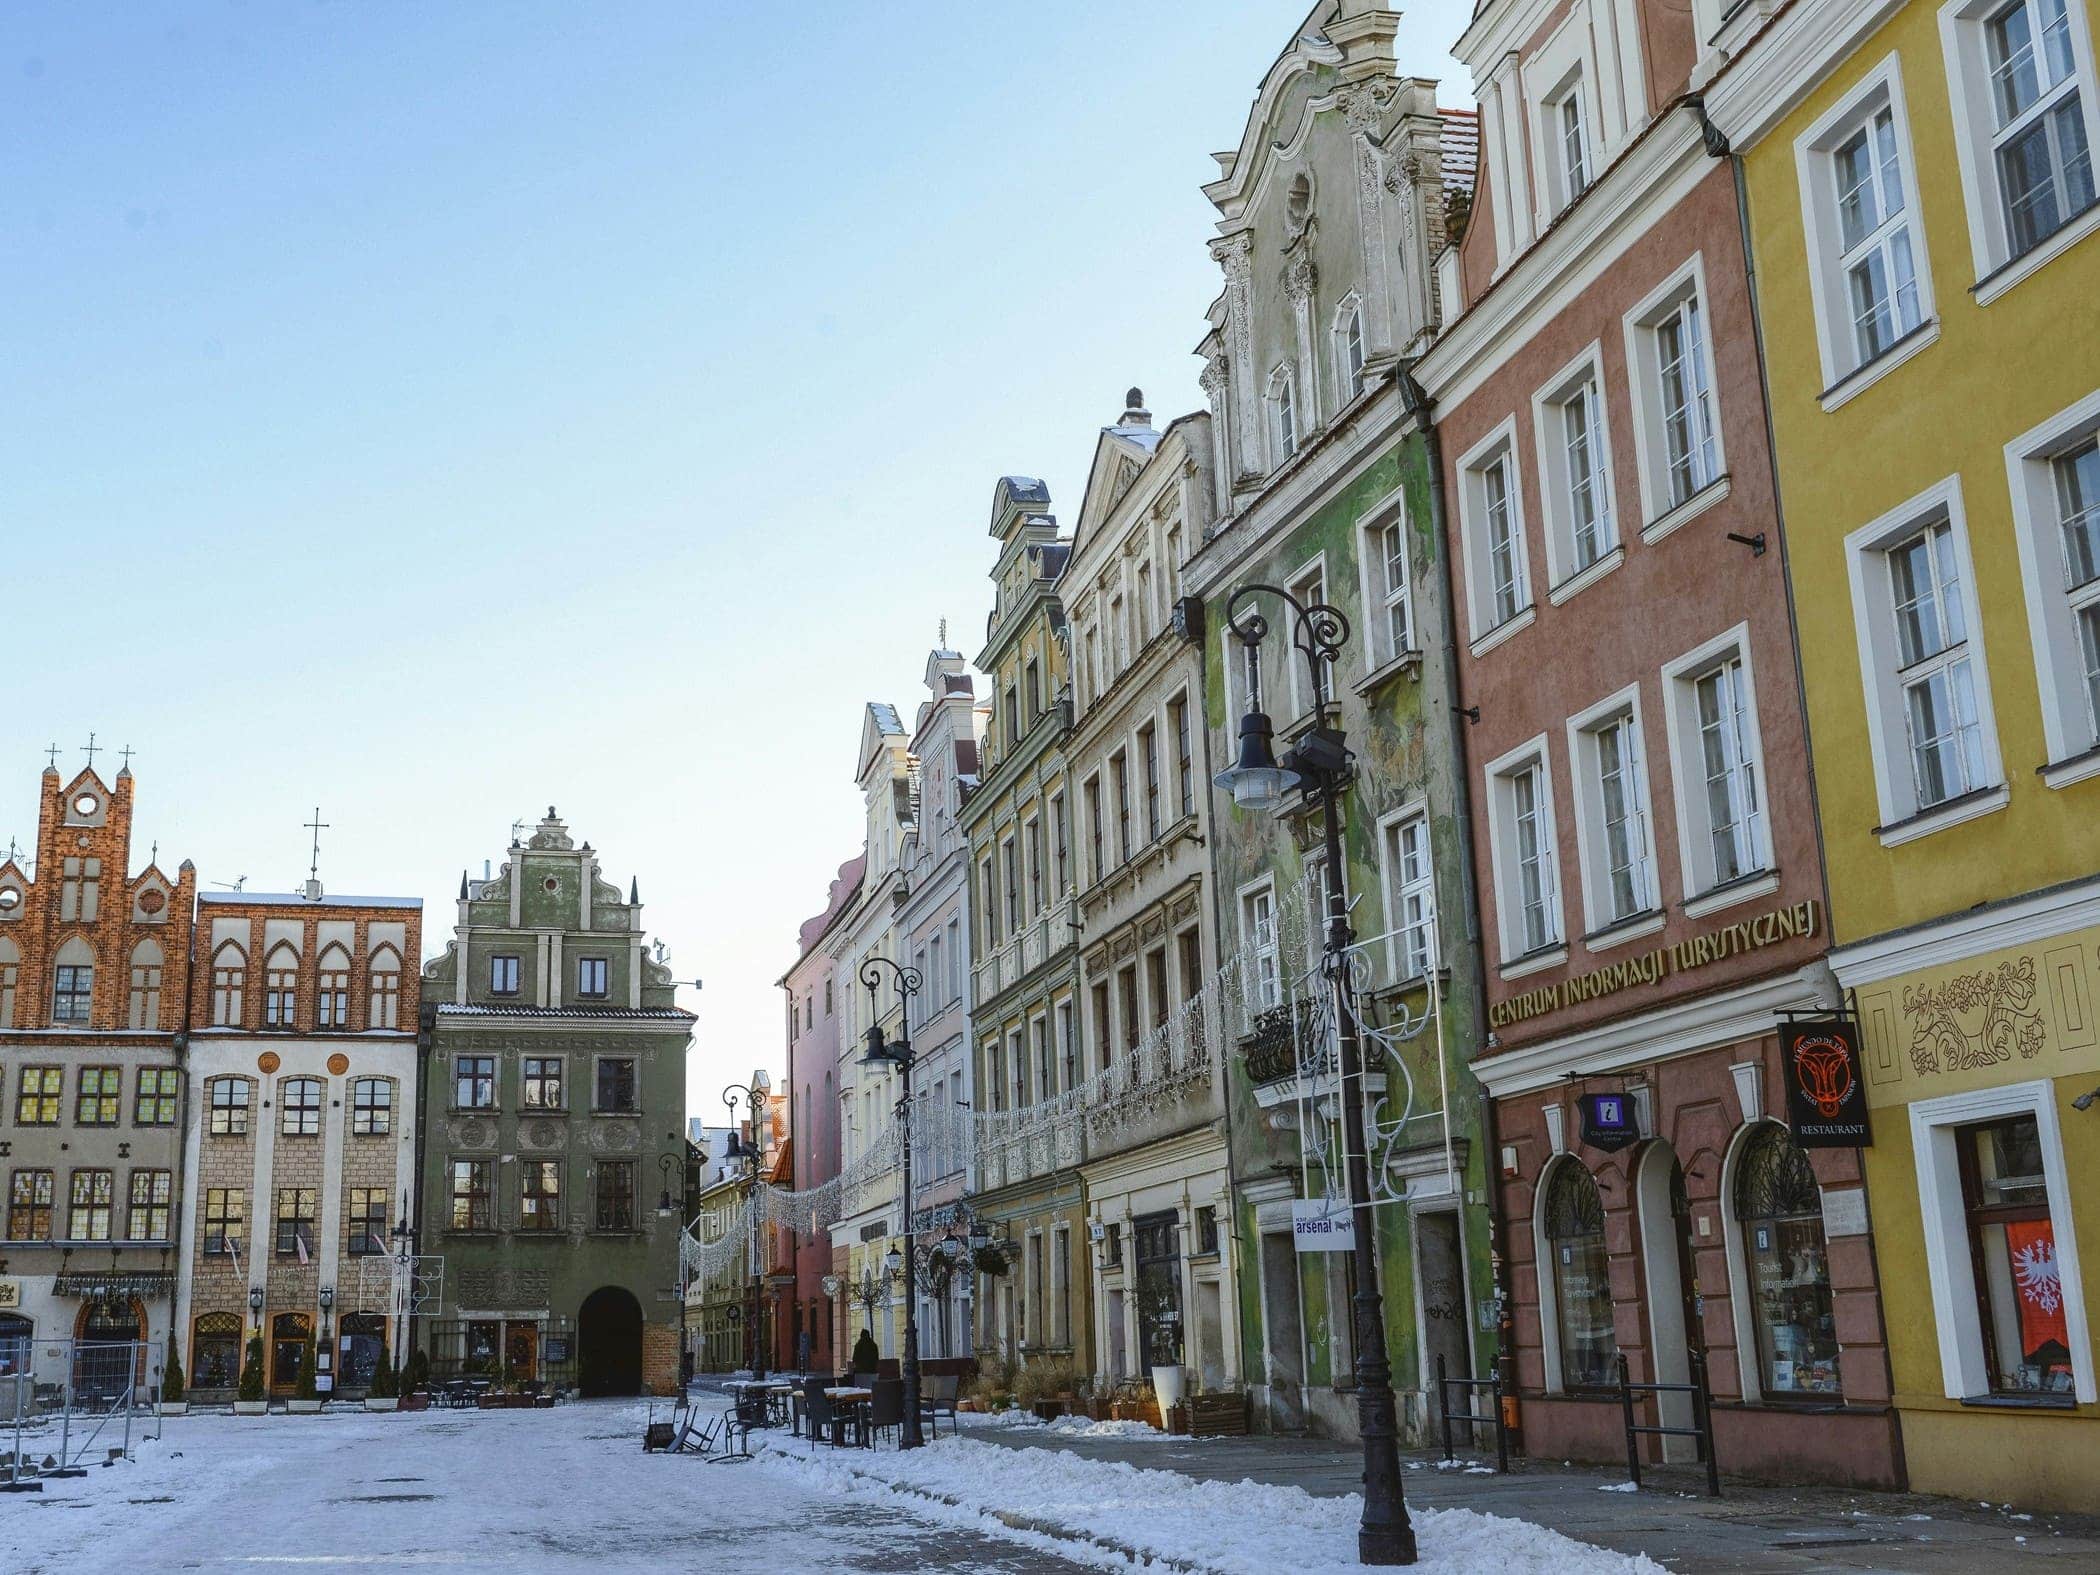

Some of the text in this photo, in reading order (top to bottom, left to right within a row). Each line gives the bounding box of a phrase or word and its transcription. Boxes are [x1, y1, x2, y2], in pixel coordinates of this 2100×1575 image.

[1488, 900, 1816, 1028] CENTRUM INFORMACJI TURYSTYCZNEJ
[1801, 1124, 1865, 1135] RESTAURANT
[1296, 1218, 1332, 1234] arsenal
[1758, 1263, 1783, 1274] Tourist
[1760, 1278, 1800, 1289] Information
